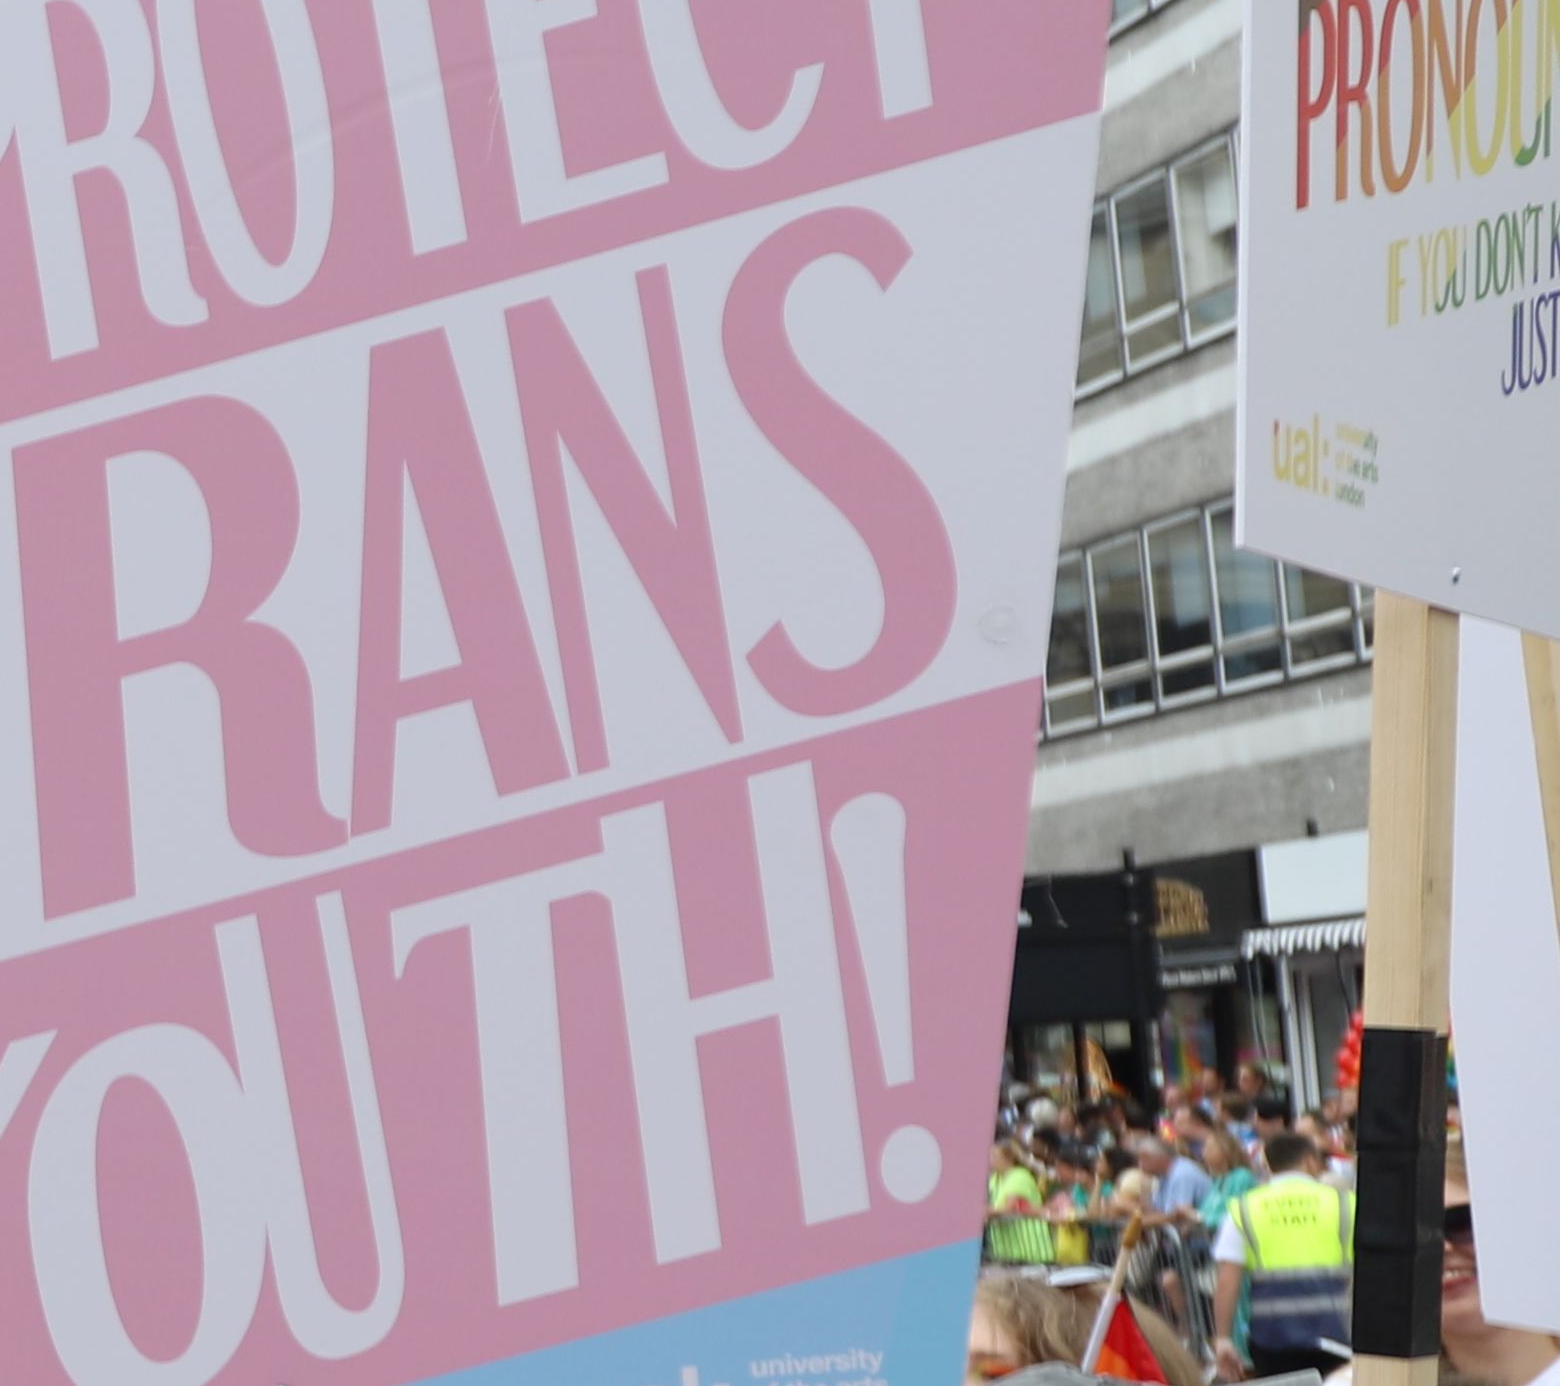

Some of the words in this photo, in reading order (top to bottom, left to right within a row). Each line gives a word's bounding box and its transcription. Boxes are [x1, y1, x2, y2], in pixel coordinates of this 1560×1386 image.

[1418, 224, 1468, 317] YOU
[1474, 203, 1544, 303] DON'T
[750, 1348, 886, 1379] university
